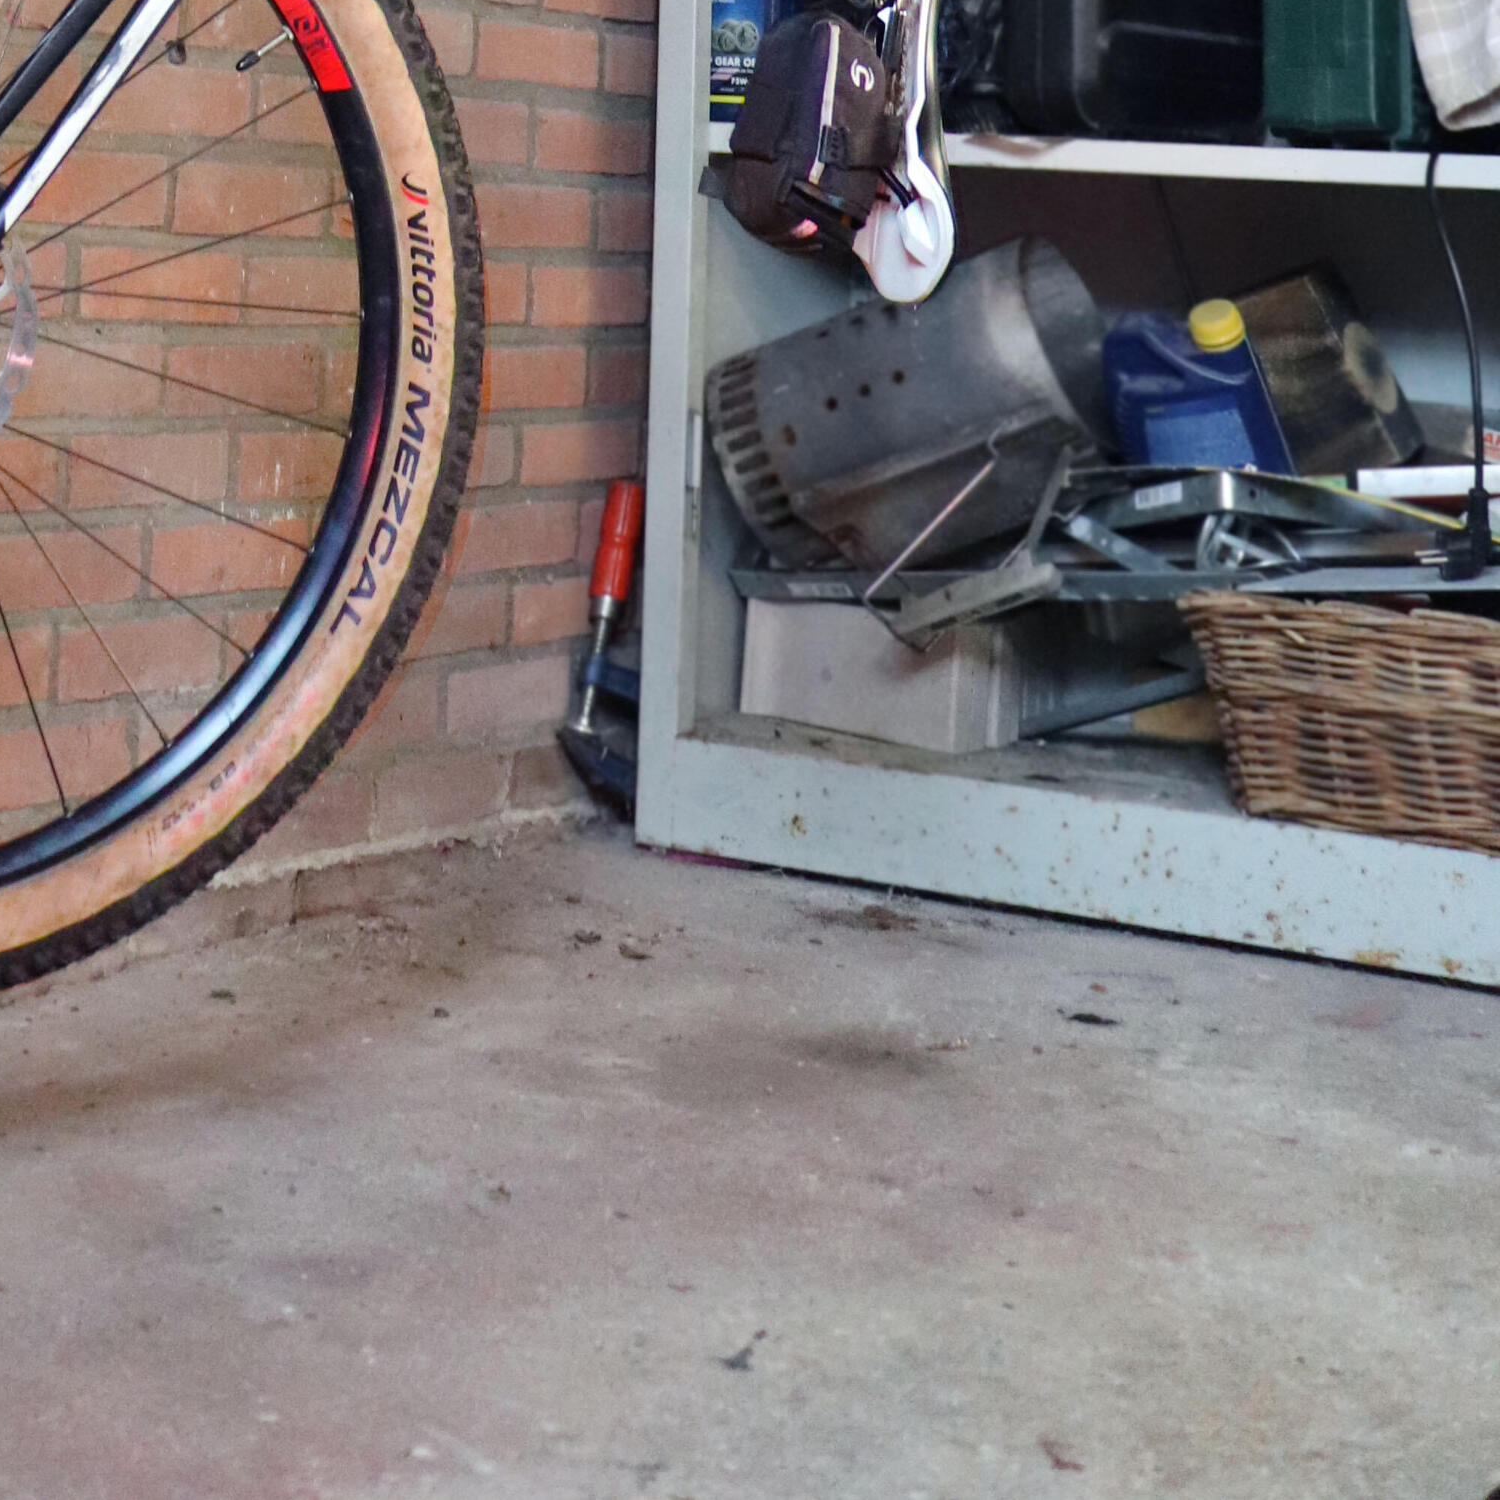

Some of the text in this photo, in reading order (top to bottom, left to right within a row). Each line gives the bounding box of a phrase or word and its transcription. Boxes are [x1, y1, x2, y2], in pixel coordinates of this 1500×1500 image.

[714, 55, 741, 68] GEAR
[329, 208, 438, 635] vittoria MEZCAL
